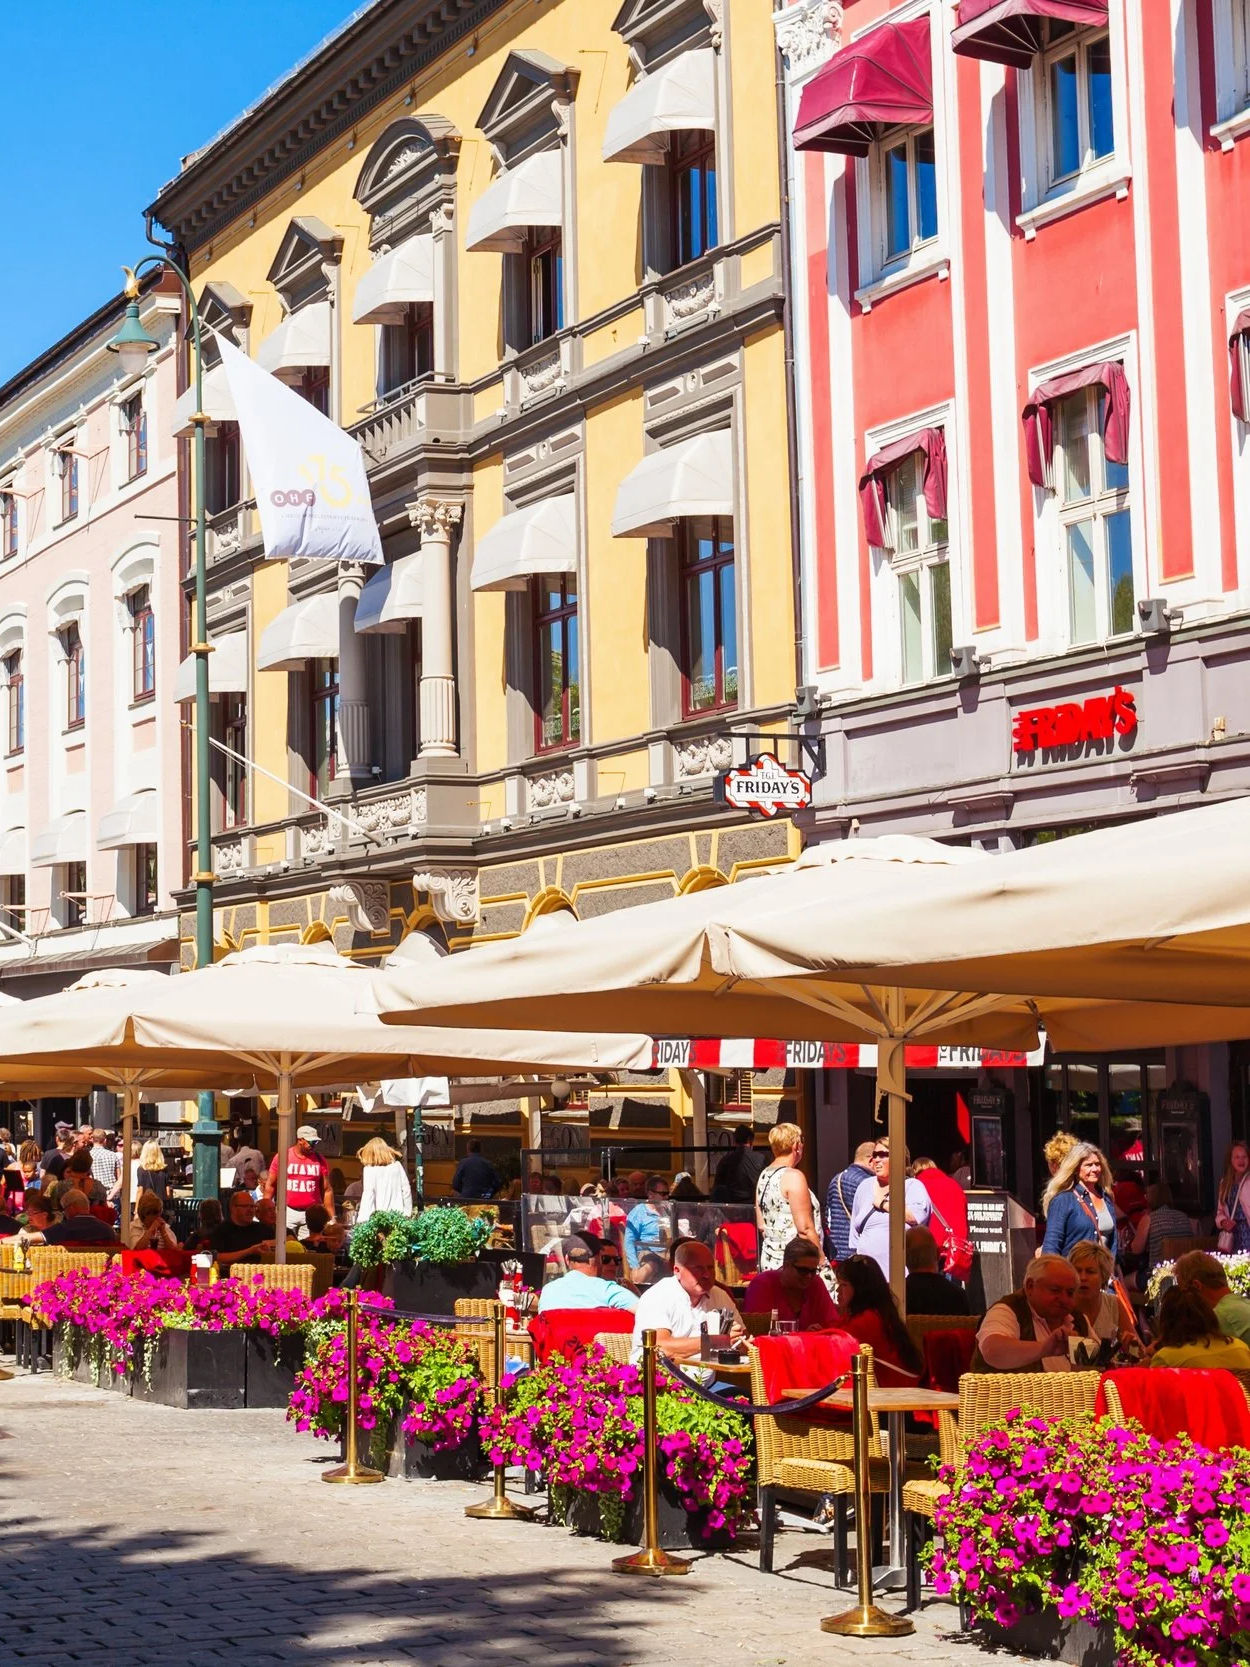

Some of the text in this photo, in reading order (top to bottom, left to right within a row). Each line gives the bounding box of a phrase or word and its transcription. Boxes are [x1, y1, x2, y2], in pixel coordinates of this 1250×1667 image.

[273, 491, 314, 505] OHF
[736, 780, 800, 795] FRIDAY'S
[651, 1041, 697, 1064] RIDAYS
[785, 1040, 847, 1063] FRIDAYS
